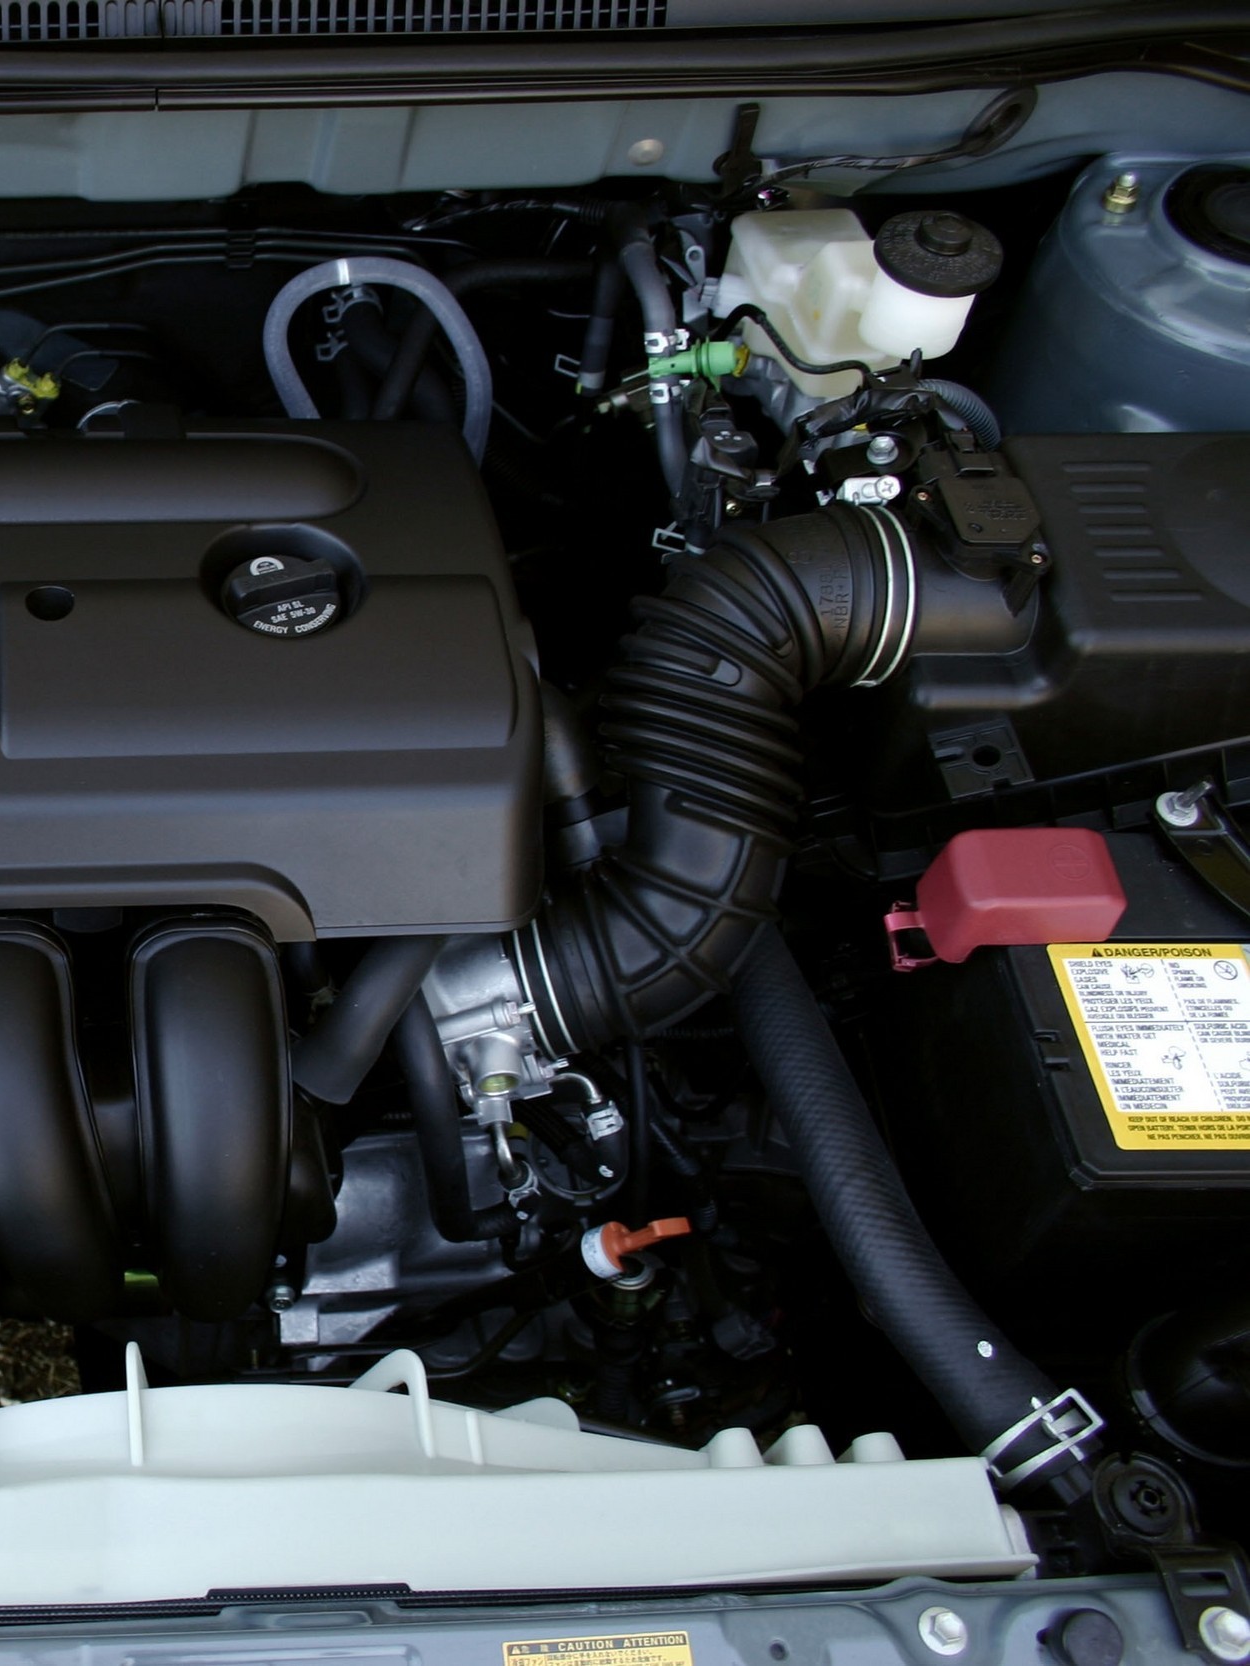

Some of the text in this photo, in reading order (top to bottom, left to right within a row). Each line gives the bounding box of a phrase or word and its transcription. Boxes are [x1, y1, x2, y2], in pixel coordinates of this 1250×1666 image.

[276, 600, 305, 613] API SL
[253, 603, 337, 634] ENERGY CONSERVING
[270, 607, 317, 624] SAE 5W-30
[1103, 948, 1213, 957] DANGER/POISON
[557, 1635, 685, 1652] CAUTION ATTENTION
